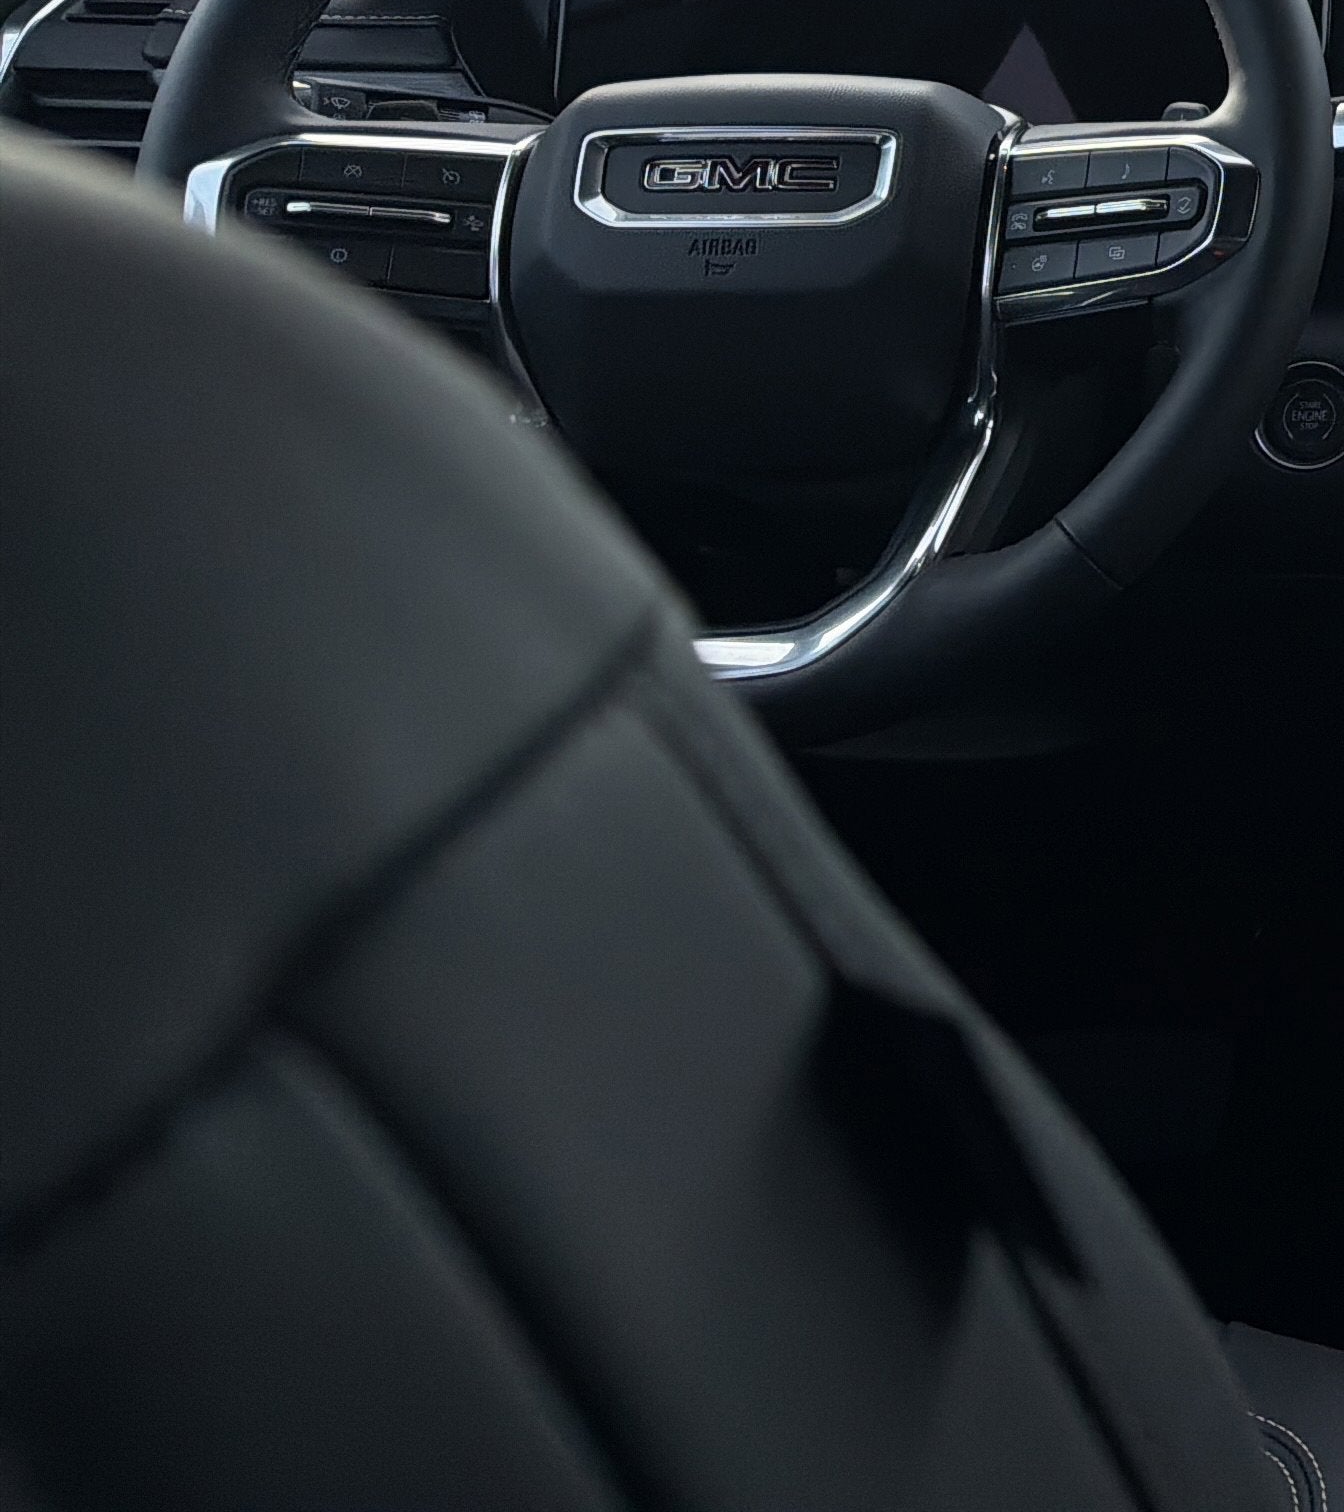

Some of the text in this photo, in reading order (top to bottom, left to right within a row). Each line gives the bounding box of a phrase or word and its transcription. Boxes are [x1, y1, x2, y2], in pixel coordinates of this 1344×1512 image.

[642, 156, 840, 193] GMC
[688, 238, 757, 256] AIRBAG
[1299, 401, 1321, 409] START
[1291, 410, 1328, 422] ENGINE
[1299, 422, 1320, 430] STOP
